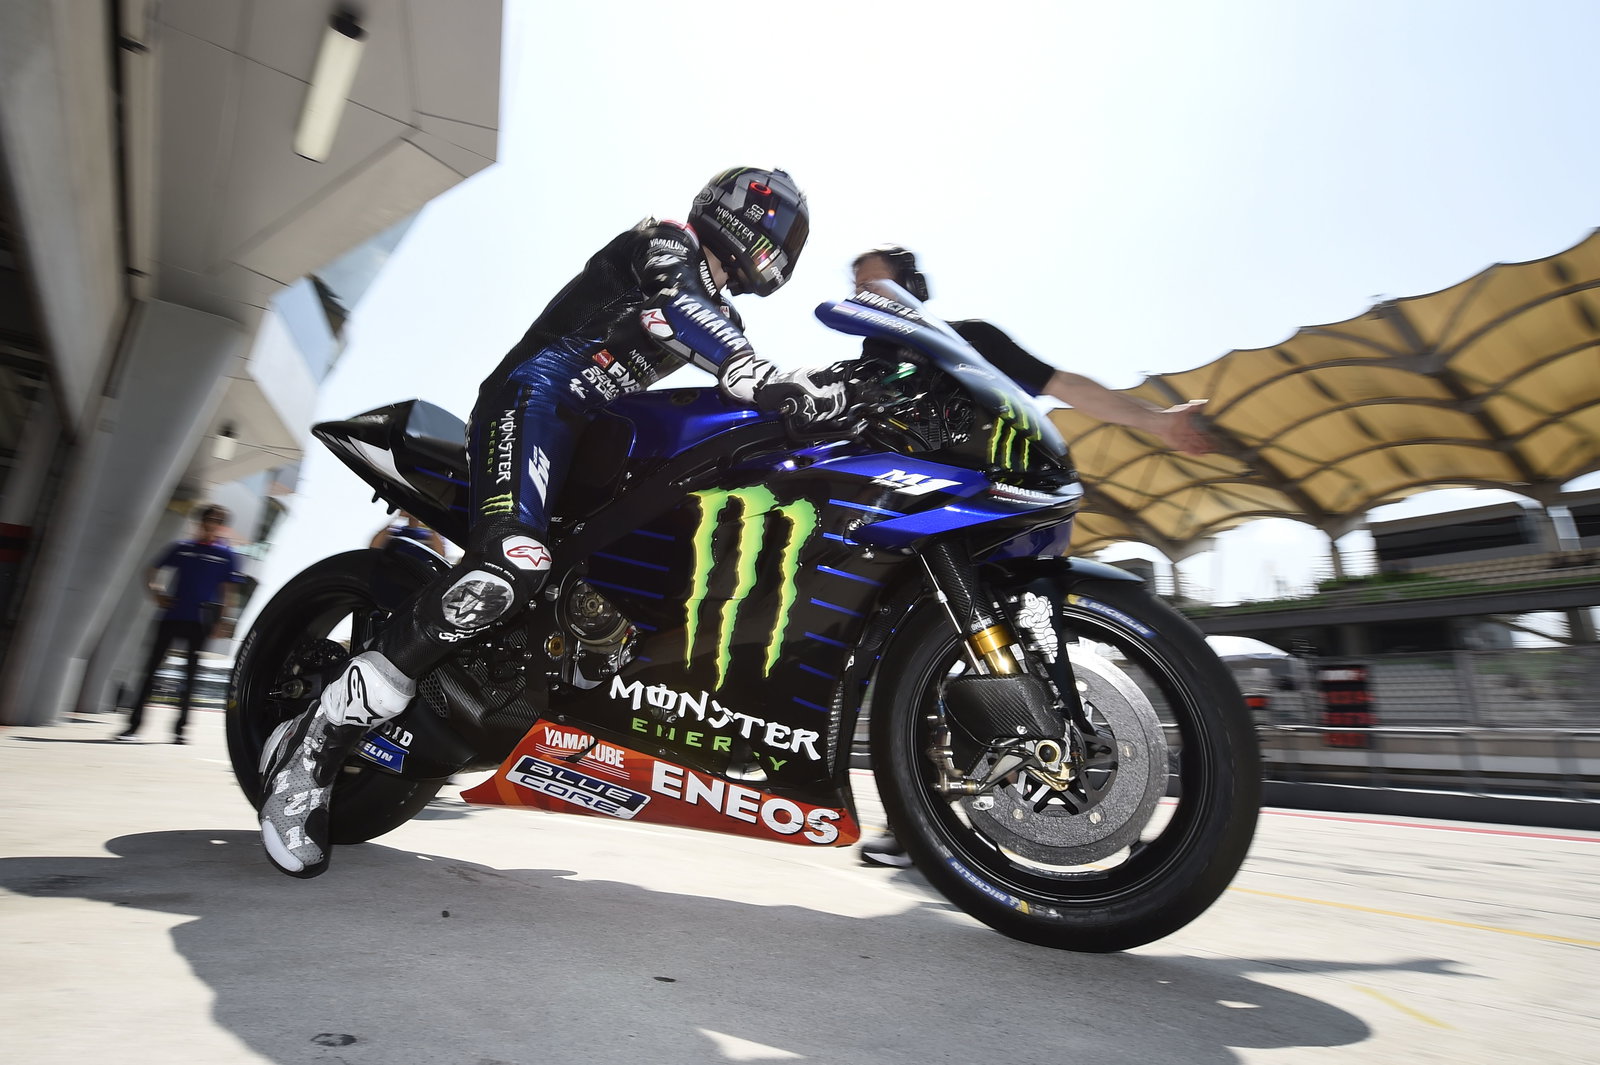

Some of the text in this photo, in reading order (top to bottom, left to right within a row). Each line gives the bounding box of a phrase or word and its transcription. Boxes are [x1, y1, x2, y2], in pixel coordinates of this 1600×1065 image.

[716, 206, 754, 241] MONSTER
[700, 260, 717, 297] YAMAHA
[672, 294, 749, 351] YAMAHA
[487, 421, 497, 473] ENERGY
[496, 409, 517, 485] MONSTER
[609, 674, 822, 761] MONSTER
[544, 726, 625, 769] YAMALUBE
[519, 774, 621, 814] CORE
[529, 761, 633, 803] BLUE
[651, 760, 842, 846] ENEOS
